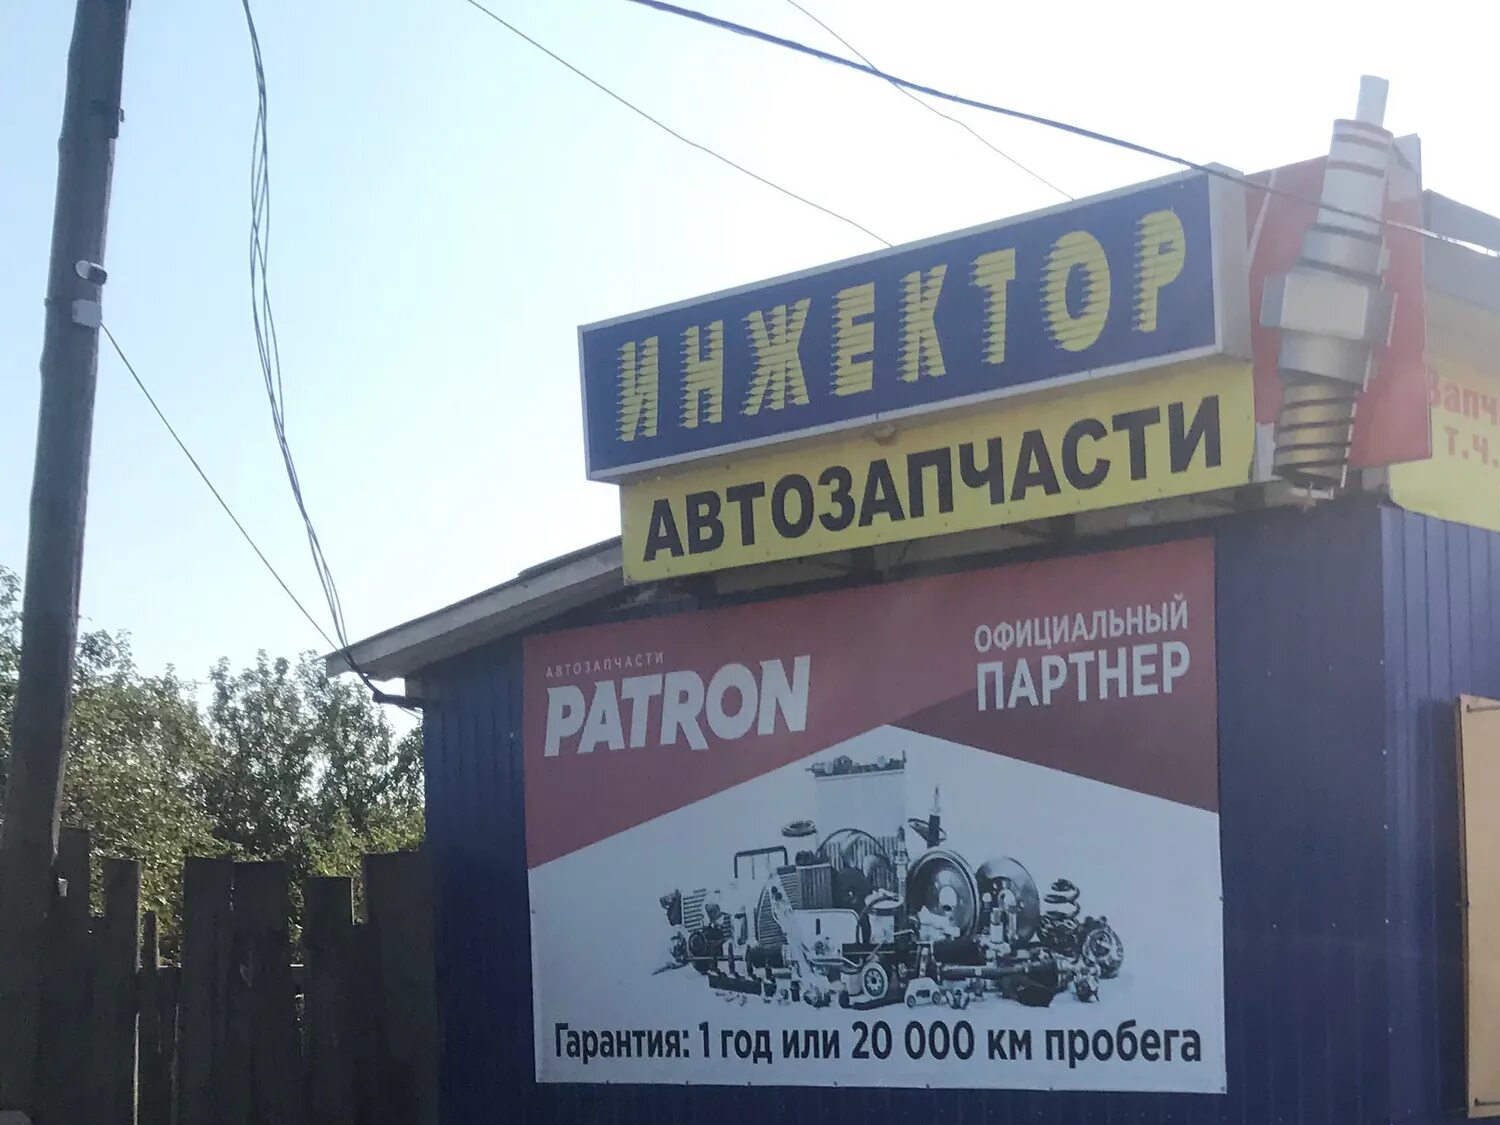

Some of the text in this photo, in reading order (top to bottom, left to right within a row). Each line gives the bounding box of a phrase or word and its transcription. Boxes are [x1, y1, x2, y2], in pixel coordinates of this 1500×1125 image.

[616, 209, 1187, 442] ИНЖЕКТОР
[643, 396, 1222, 562] АВТОЗАПЧАСТИ
[974, 593, 1189, 654] ОФИЦИАЛЬНЫЙ
[546, 651, 665, 678] АВТОЗАПЧАСТИ
[976, 641, 1191, 712] ПАРТНЕР
[544, 655, 811, 757] PATRON
[554, 1019, 1202, 1069] Гарантия: 1 год или 20 000 км пробега
